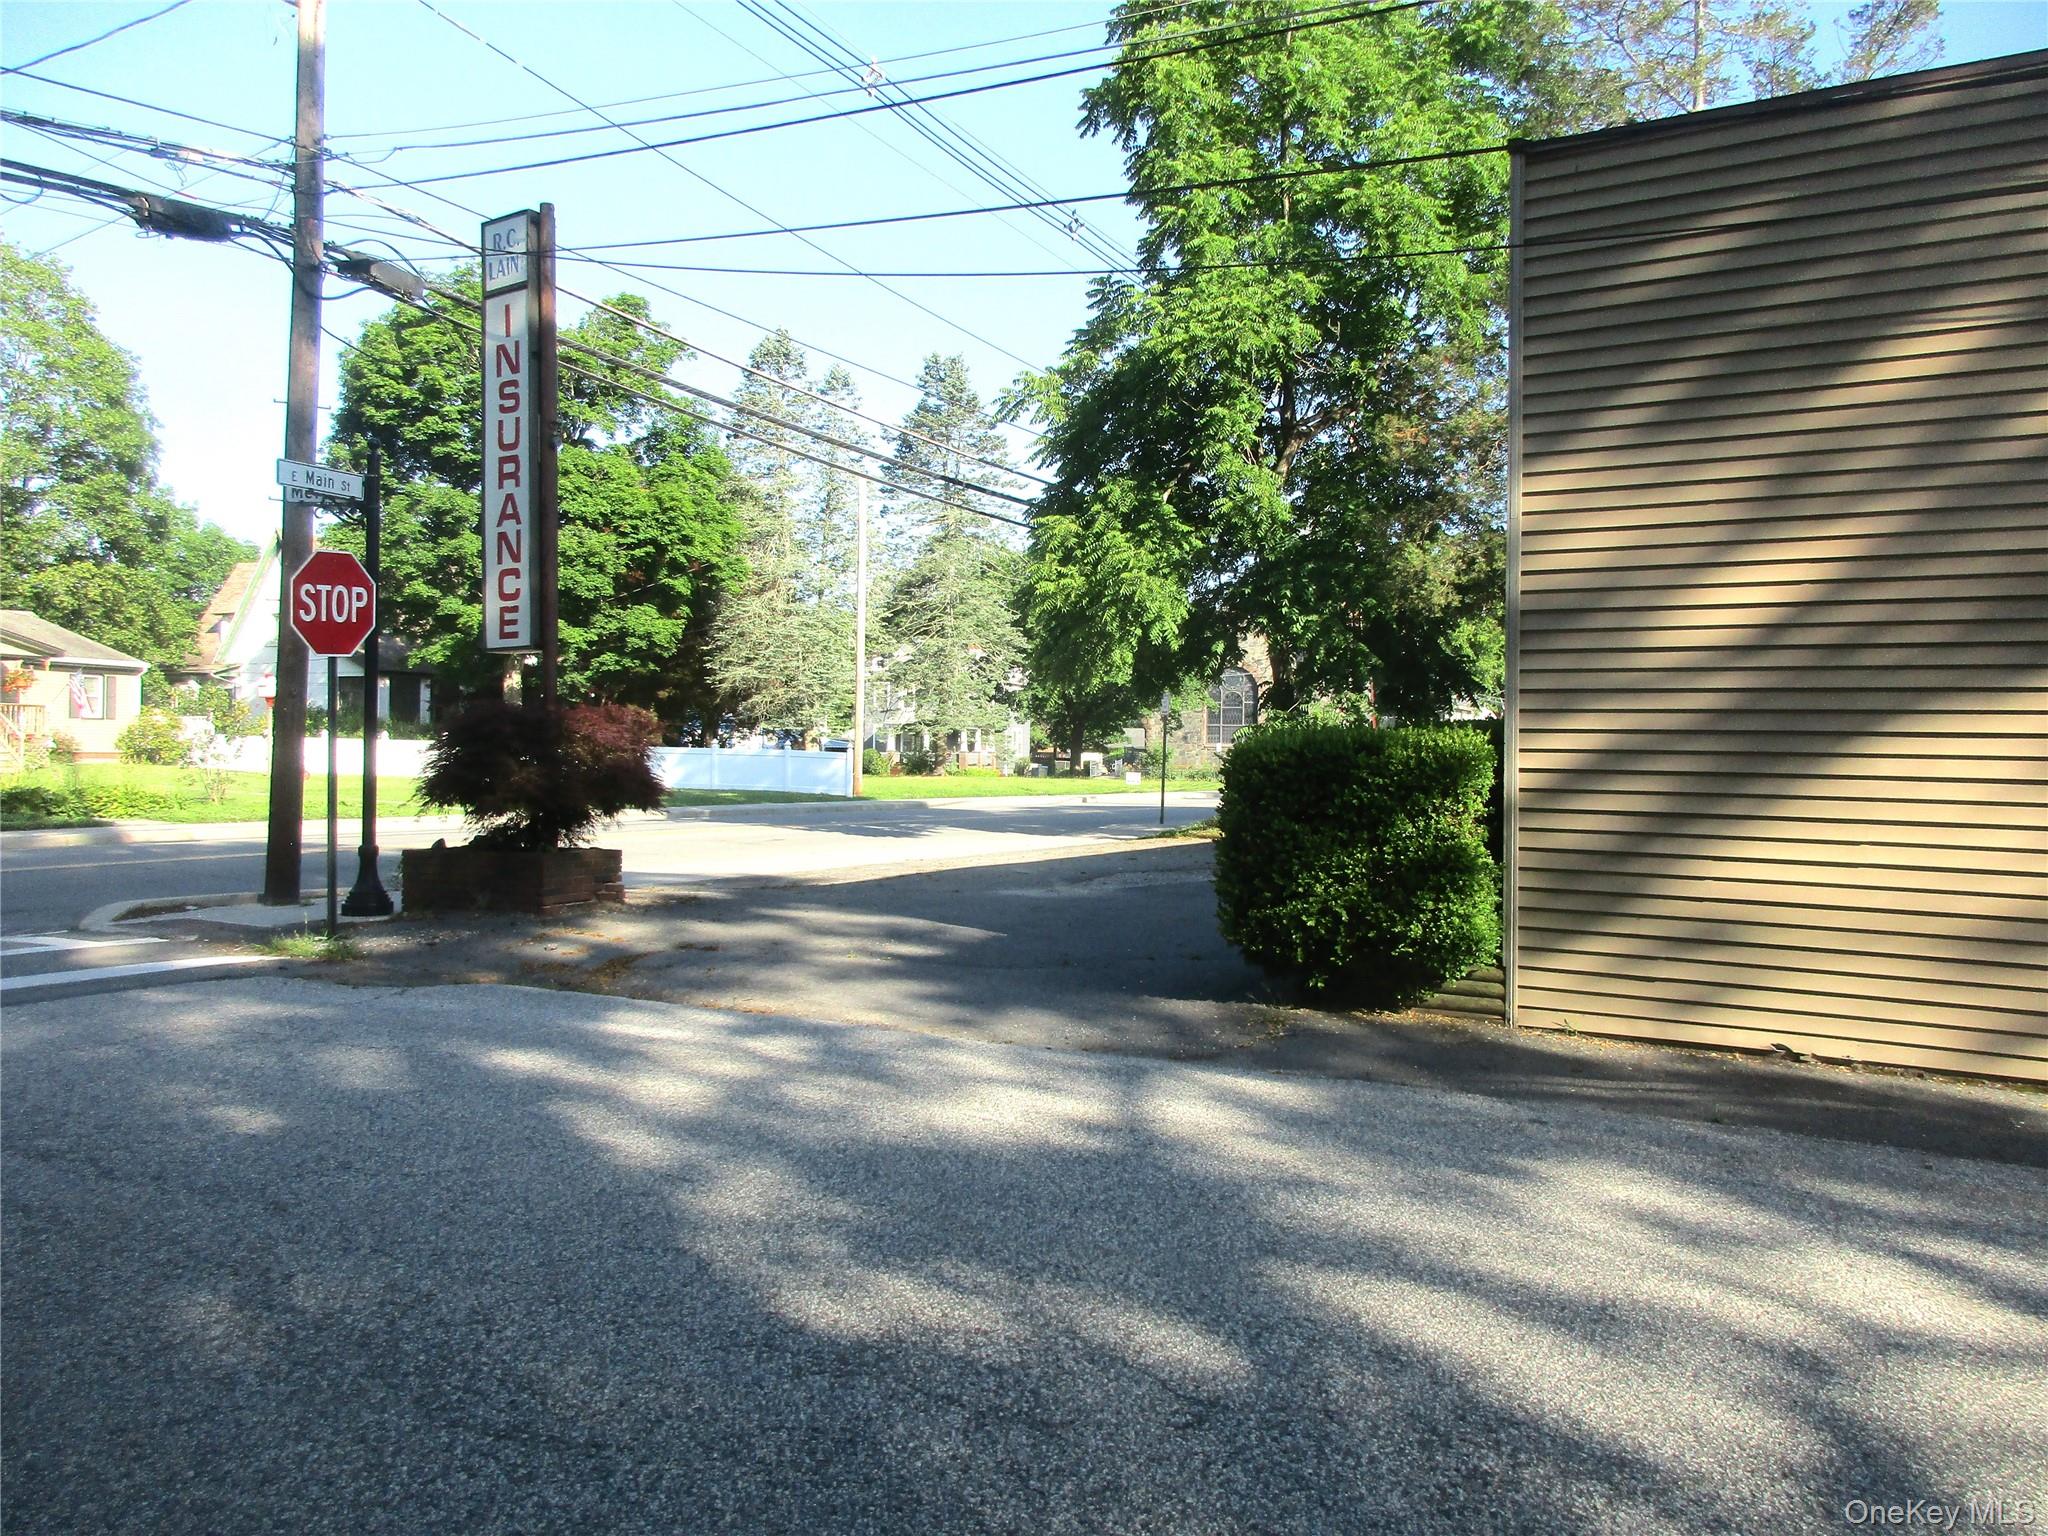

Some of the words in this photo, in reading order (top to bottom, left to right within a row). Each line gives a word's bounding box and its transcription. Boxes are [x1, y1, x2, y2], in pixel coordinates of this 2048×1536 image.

[488, 254, 519, 280] LAIN
[291, 470, 297, 482] E
[306, 470, 335, 489] Main
[341, 480, 351, 492] St
[496, 304, 522, 640] INSURANCE
[300, 583, 368, 623] STOP
